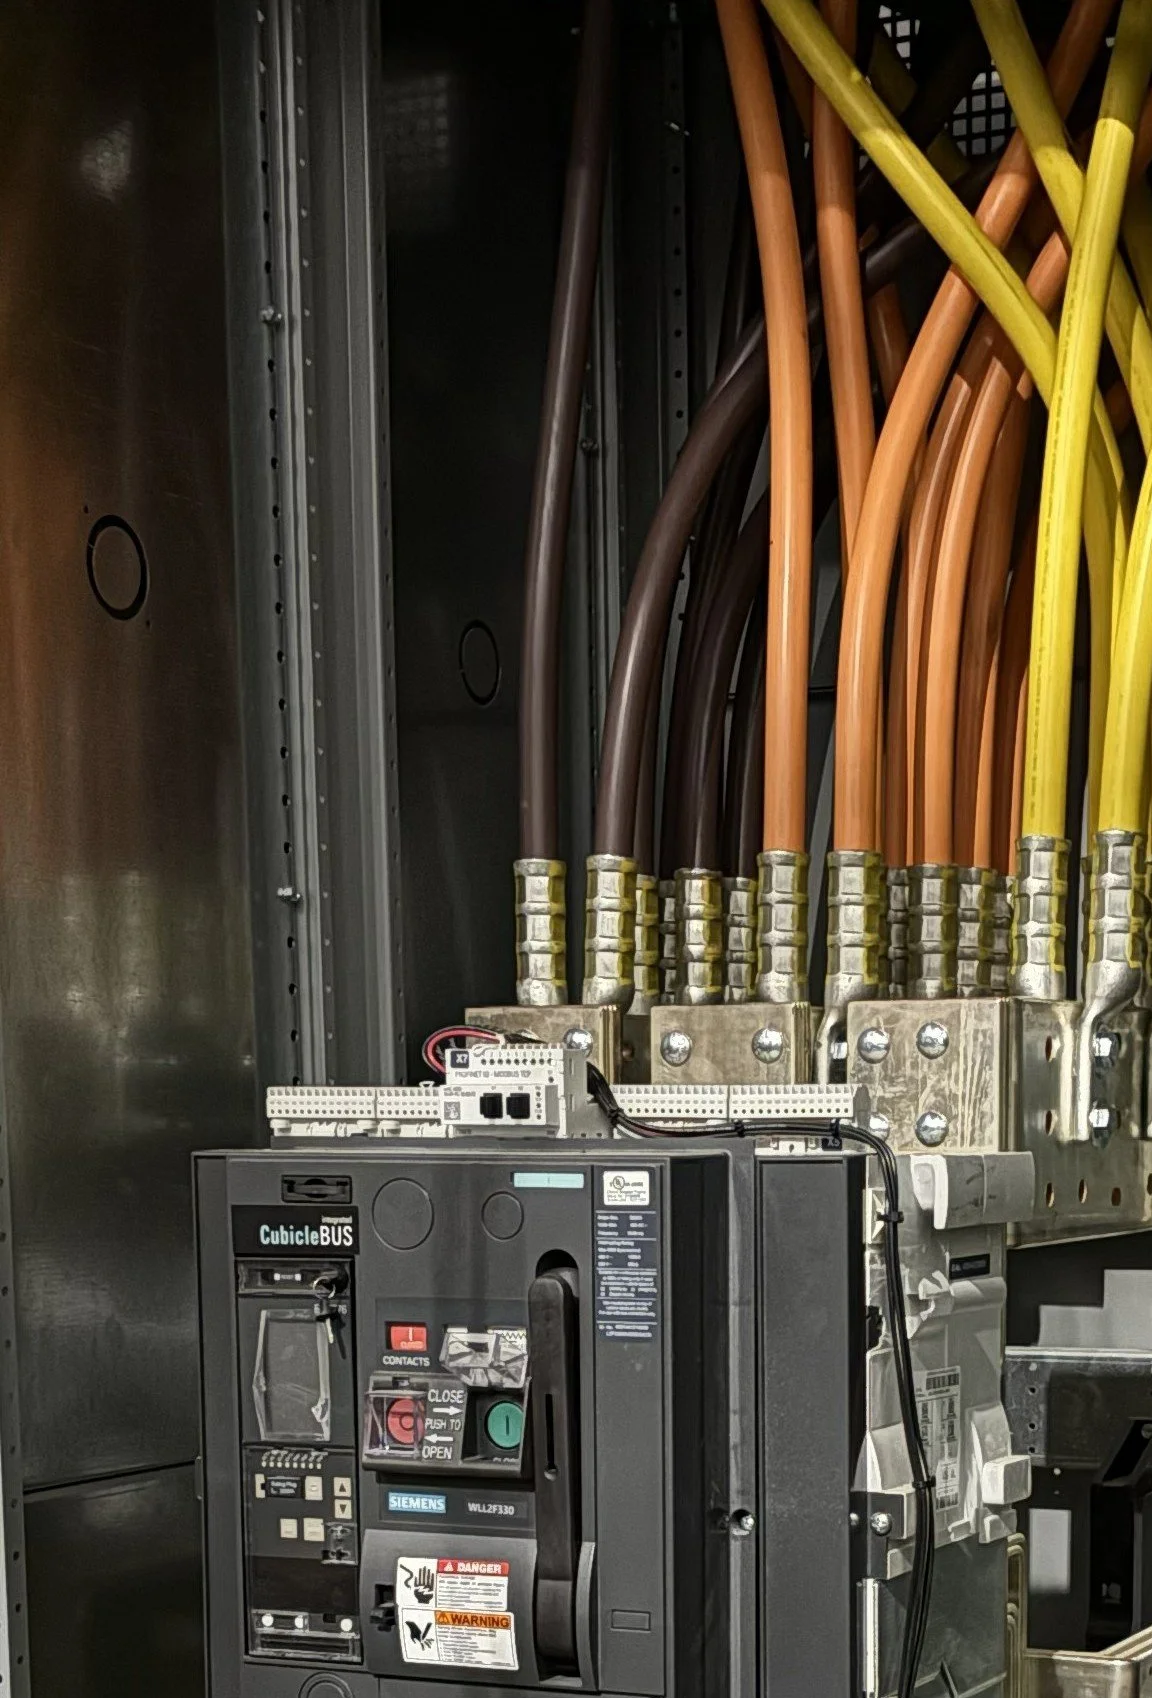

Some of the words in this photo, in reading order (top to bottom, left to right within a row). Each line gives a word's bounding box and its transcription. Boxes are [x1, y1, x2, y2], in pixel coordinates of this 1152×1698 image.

[259, 1224, 353, 1247] CubicleBUS
[382, 1355, 431, 1367] CONTACTS
[427, 1388, 465, 1404] CLOSE
[424, 1418, 446, 1430] PUSH
[449, 1418, 462, 1431] TO
[421, 1445, 453, 1460] OPEN
[389, 1495, 446, 1511] SIEMENS
[457, 1561, 502, 1575] DANGER
[450, 1613, 510, 1628] WARNING
